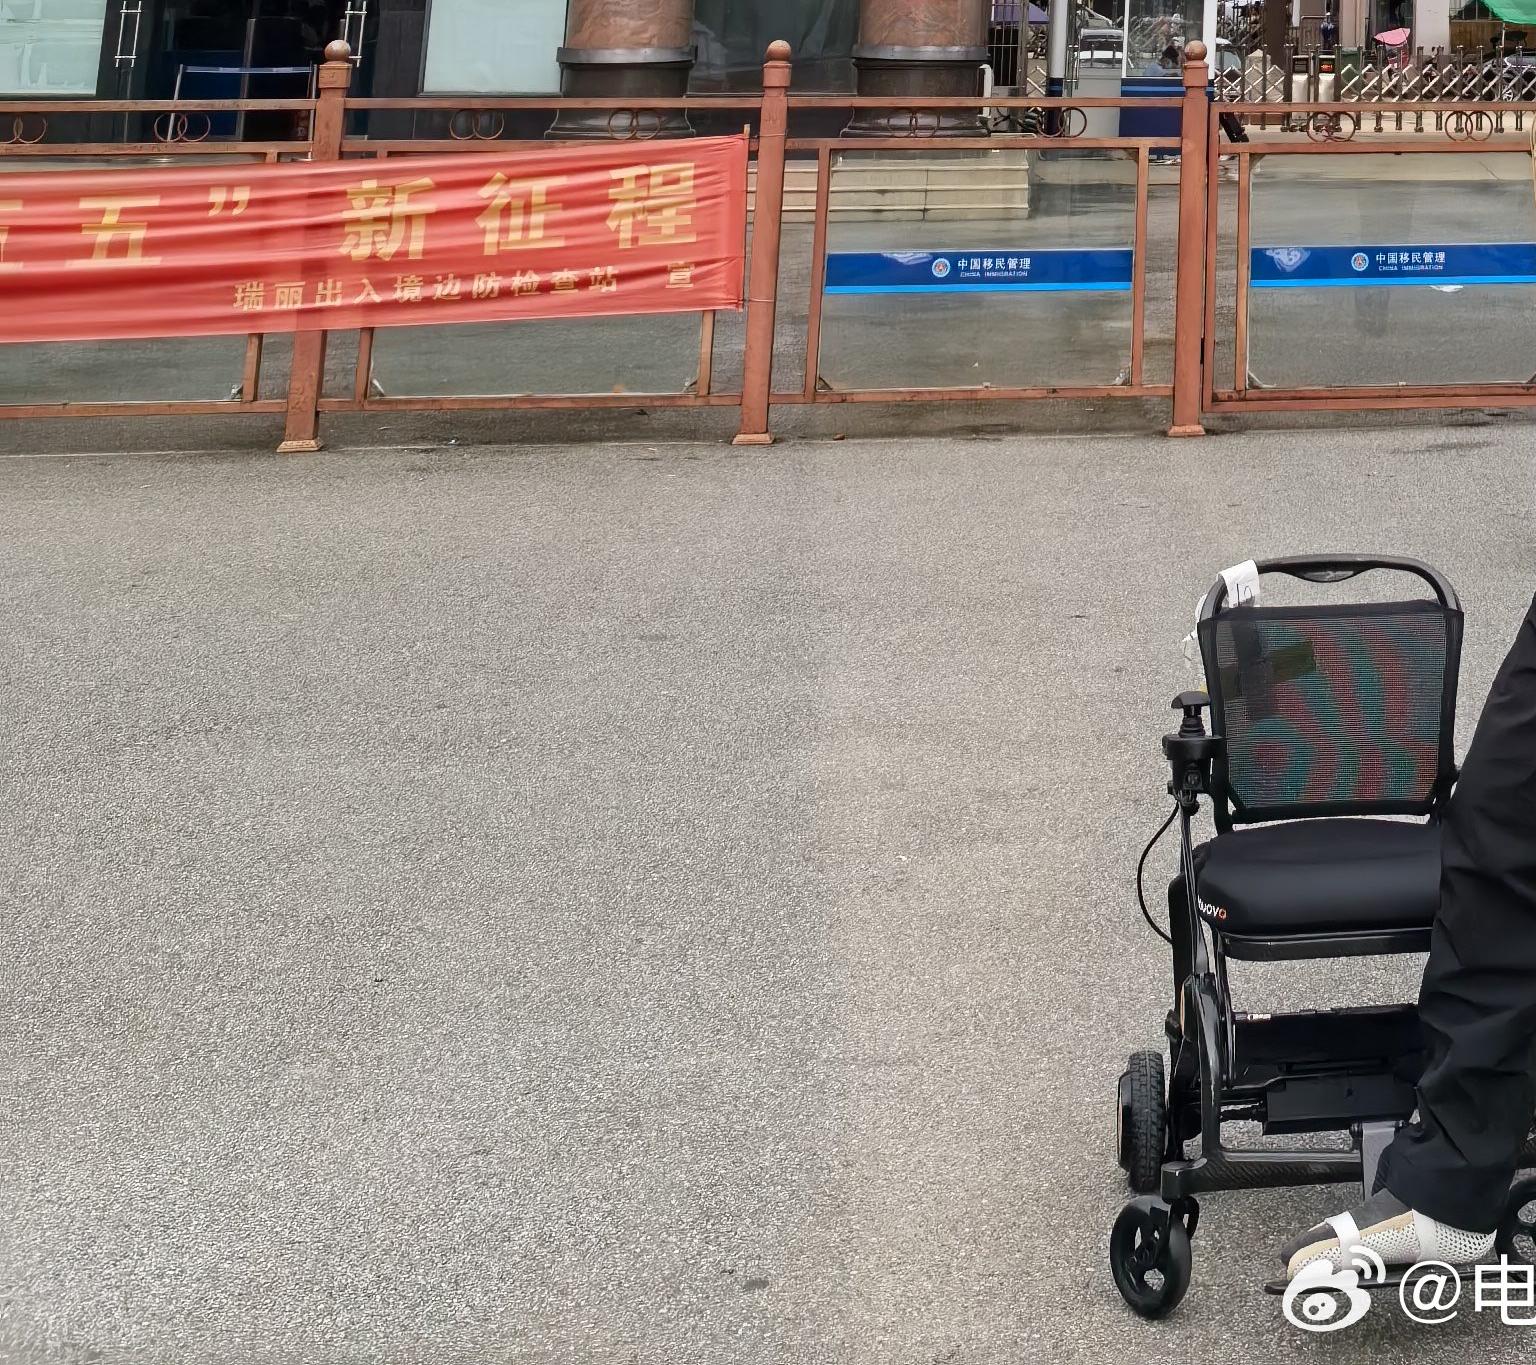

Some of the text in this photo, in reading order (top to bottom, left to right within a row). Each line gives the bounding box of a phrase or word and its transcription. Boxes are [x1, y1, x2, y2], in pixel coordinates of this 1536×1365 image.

[0, 160, 698, 270] 五”新征程
[957, 257, 1031, 271] 中国移民管理
[1375, 251, 1446, 265] 中国移民管理
[233, 259, 697, 312] 瑞丽出入境边防检查站 宣
